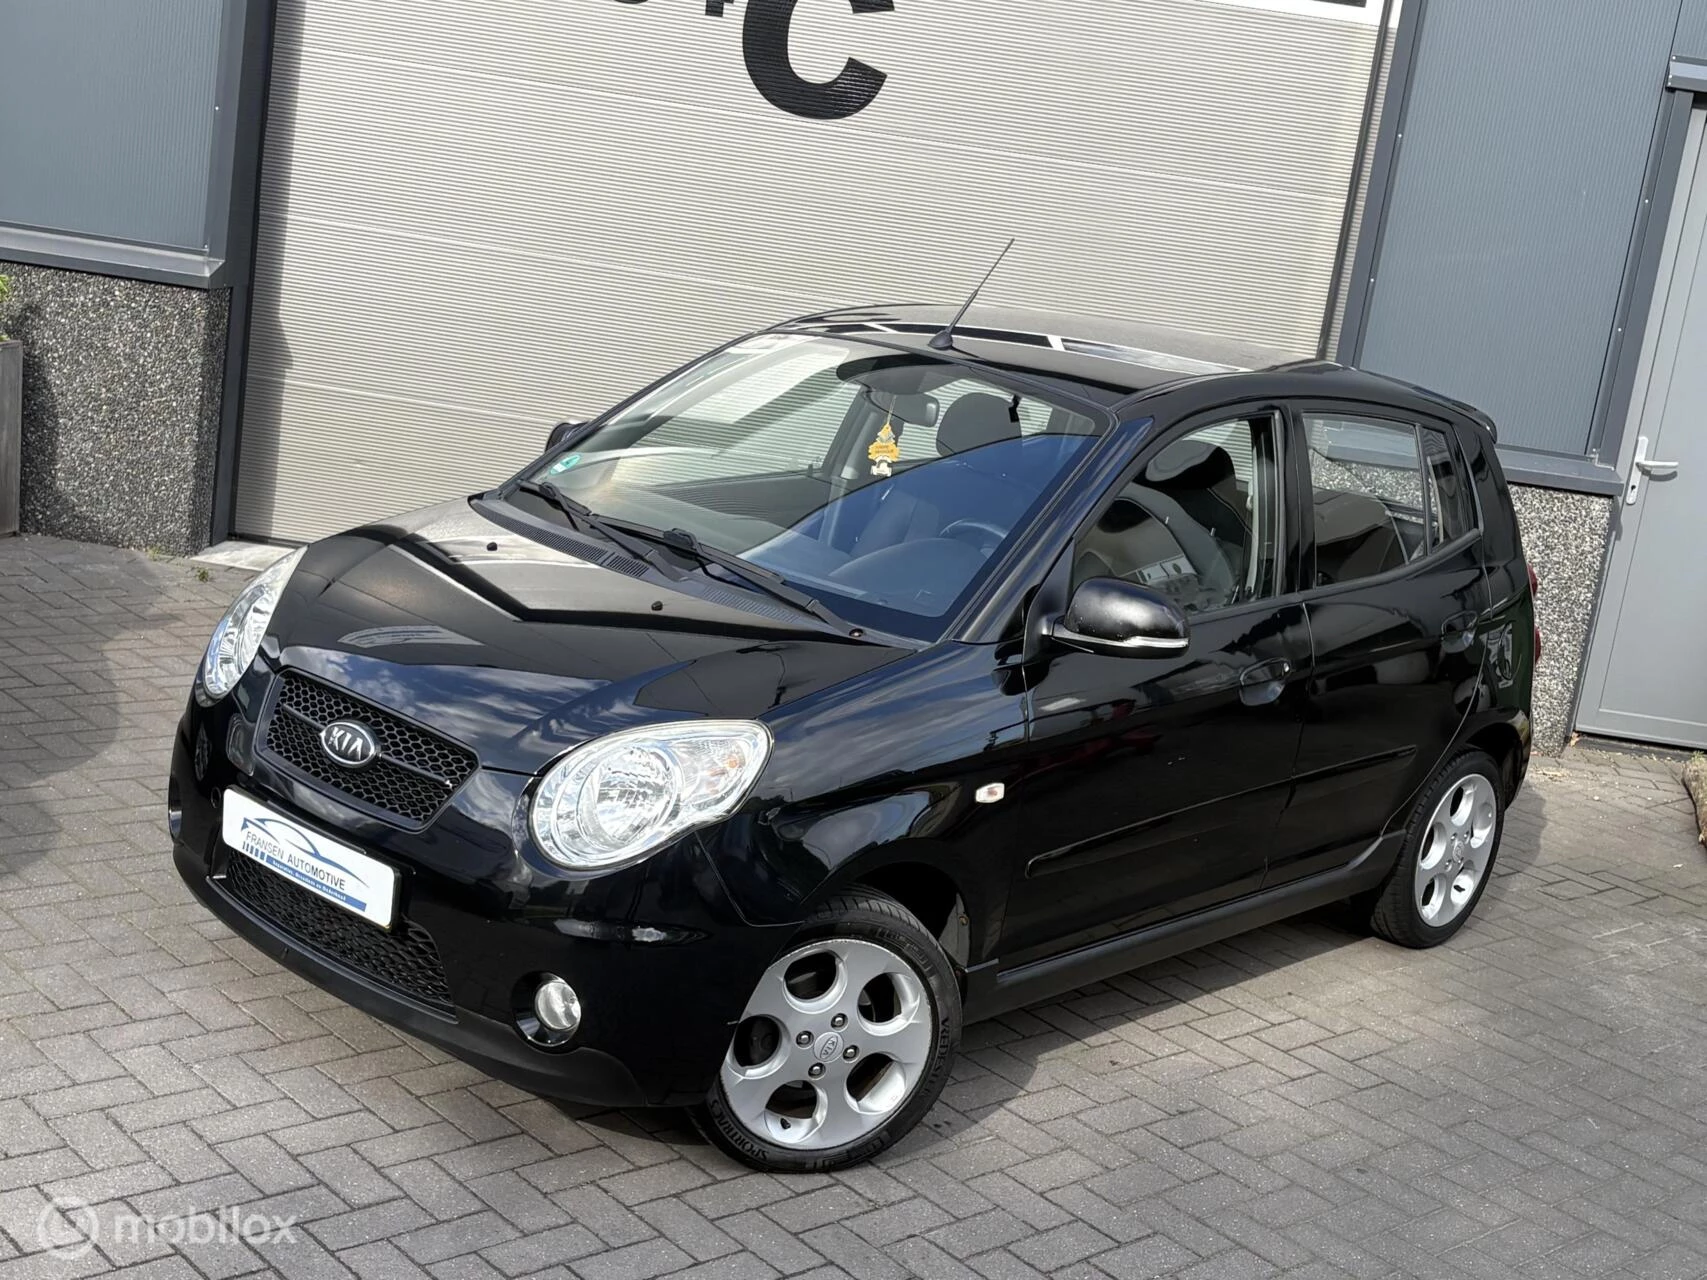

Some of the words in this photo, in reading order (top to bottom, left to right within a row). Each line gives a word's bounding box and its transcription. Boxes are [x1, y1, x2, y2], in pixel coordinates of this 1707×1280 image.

[327, 726, 363, 760] KIA
[246, 831, 285, 860] FRANSEN
[287, 851, 346, 891] AUTOMOTIVE
